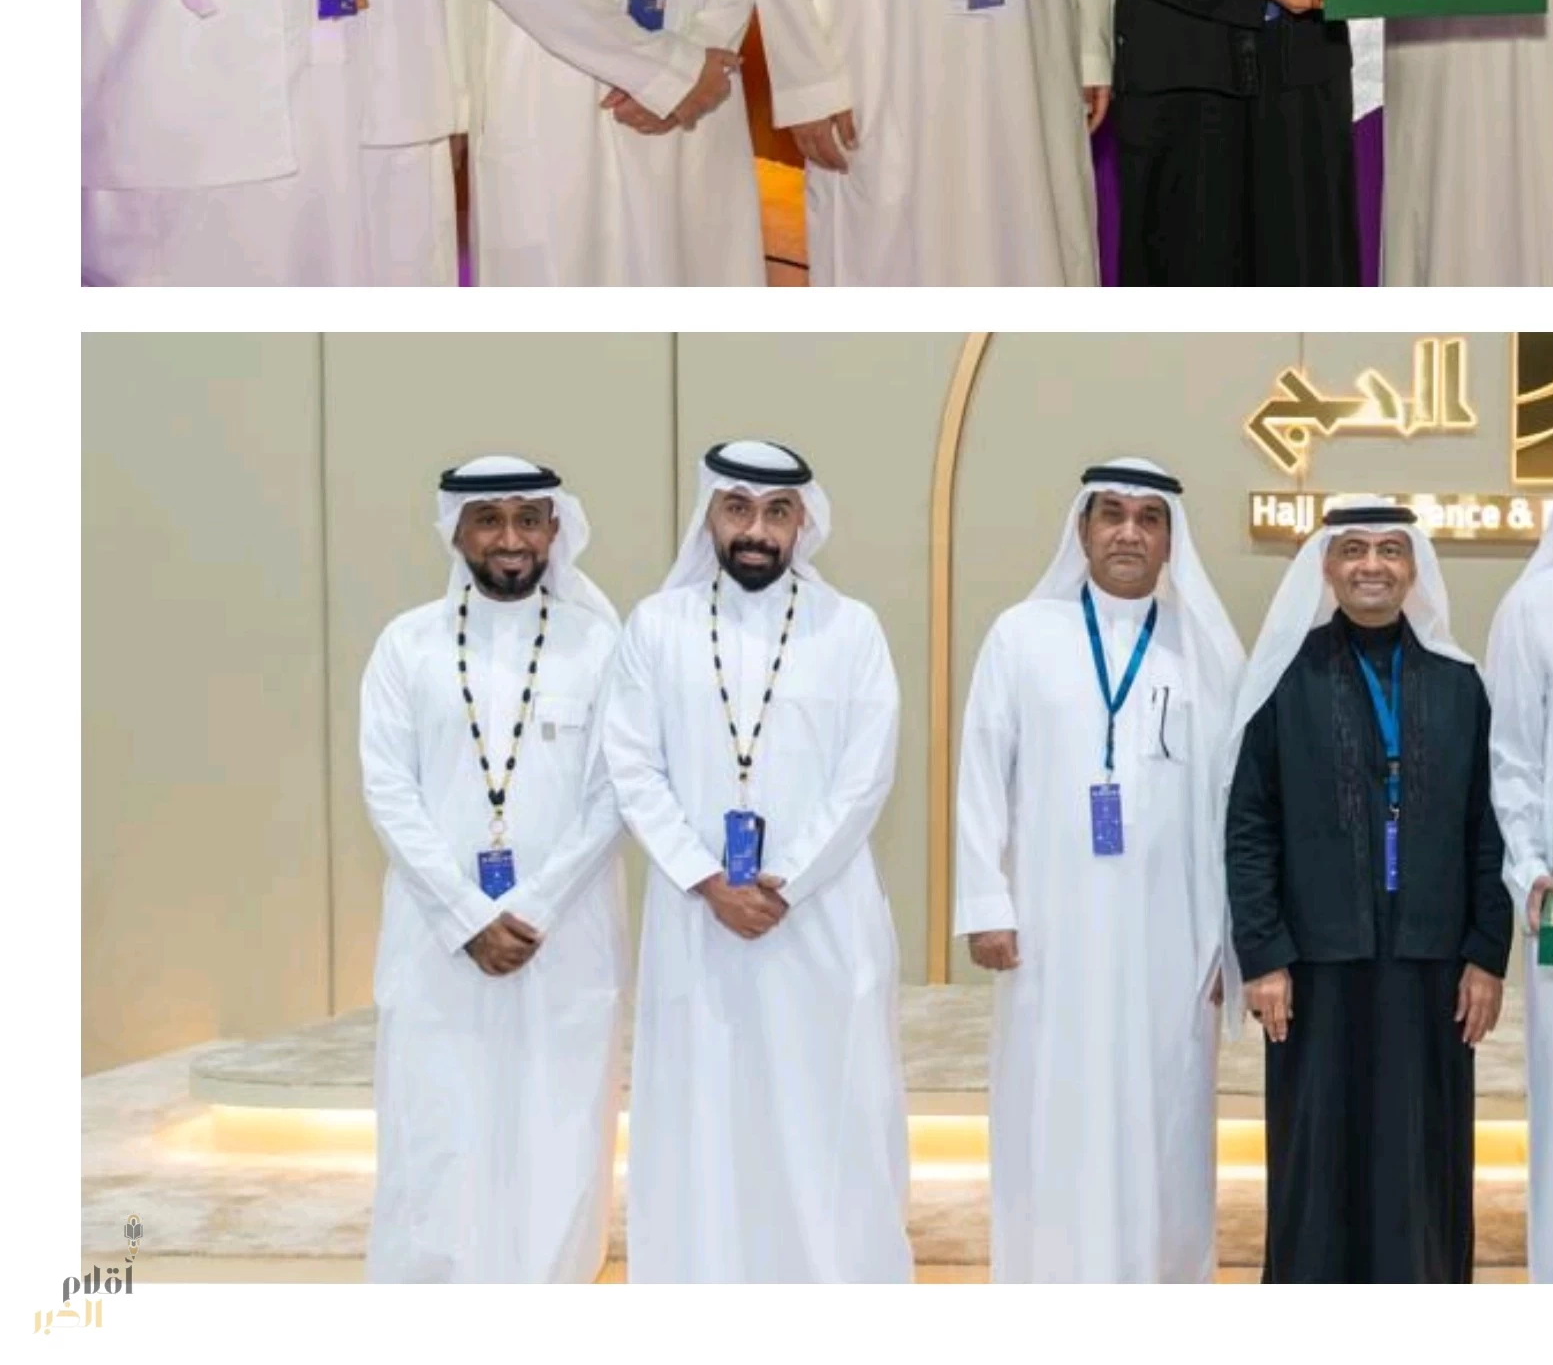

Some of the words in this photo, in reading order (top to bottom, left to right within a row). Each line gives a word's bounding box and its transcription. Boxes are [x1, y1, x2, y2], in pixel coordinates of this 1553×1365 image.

[1246, 337, 1477, 473] الحج
[1253, 495, 1314, 534] Hajj
[1507, 498, 1535, 530] &
